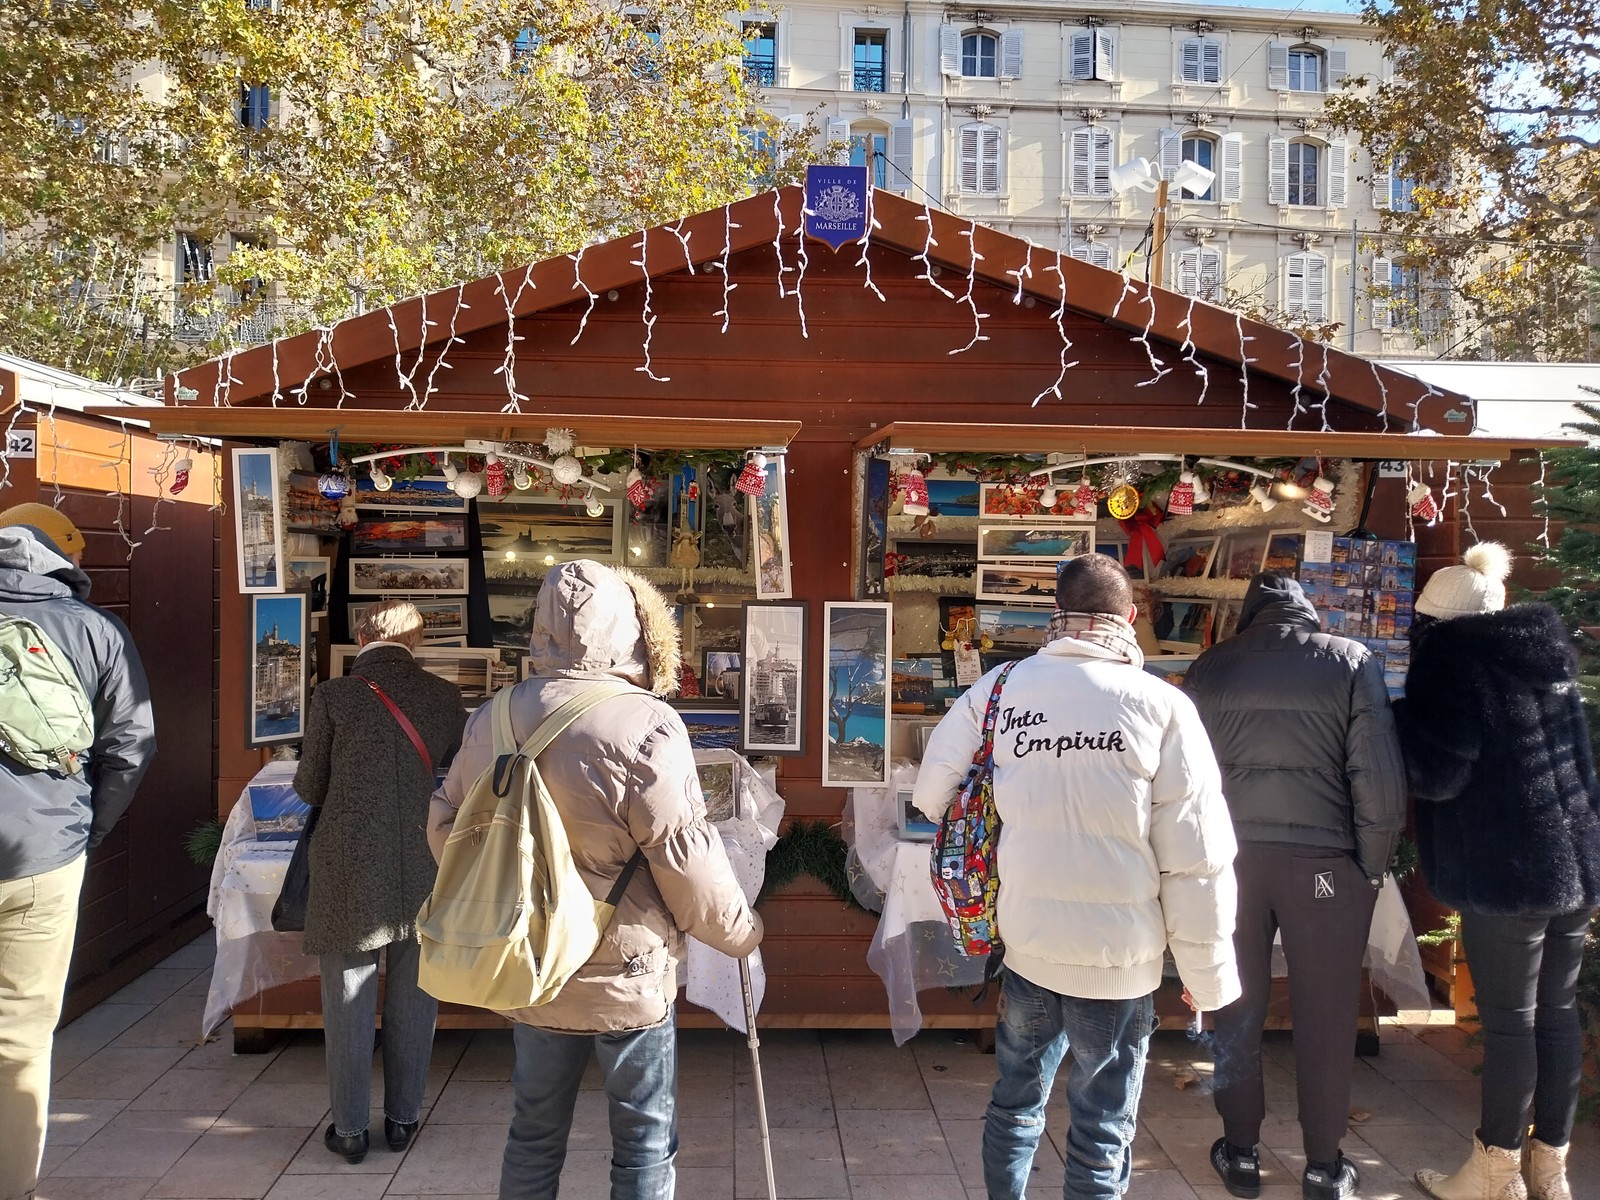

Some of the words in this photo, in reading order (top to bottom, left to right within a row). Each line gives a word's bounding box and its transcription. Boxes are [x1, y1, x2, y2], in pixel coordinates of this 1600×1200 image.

[815, 222, 857, 230] MARSEILLE
[9, 437, 33, 453] 42
[1380, 460, 1405, 472] 43
[1000, 706, 1048, 735] Into
[1013, 730, 1126, 758] Empirik
